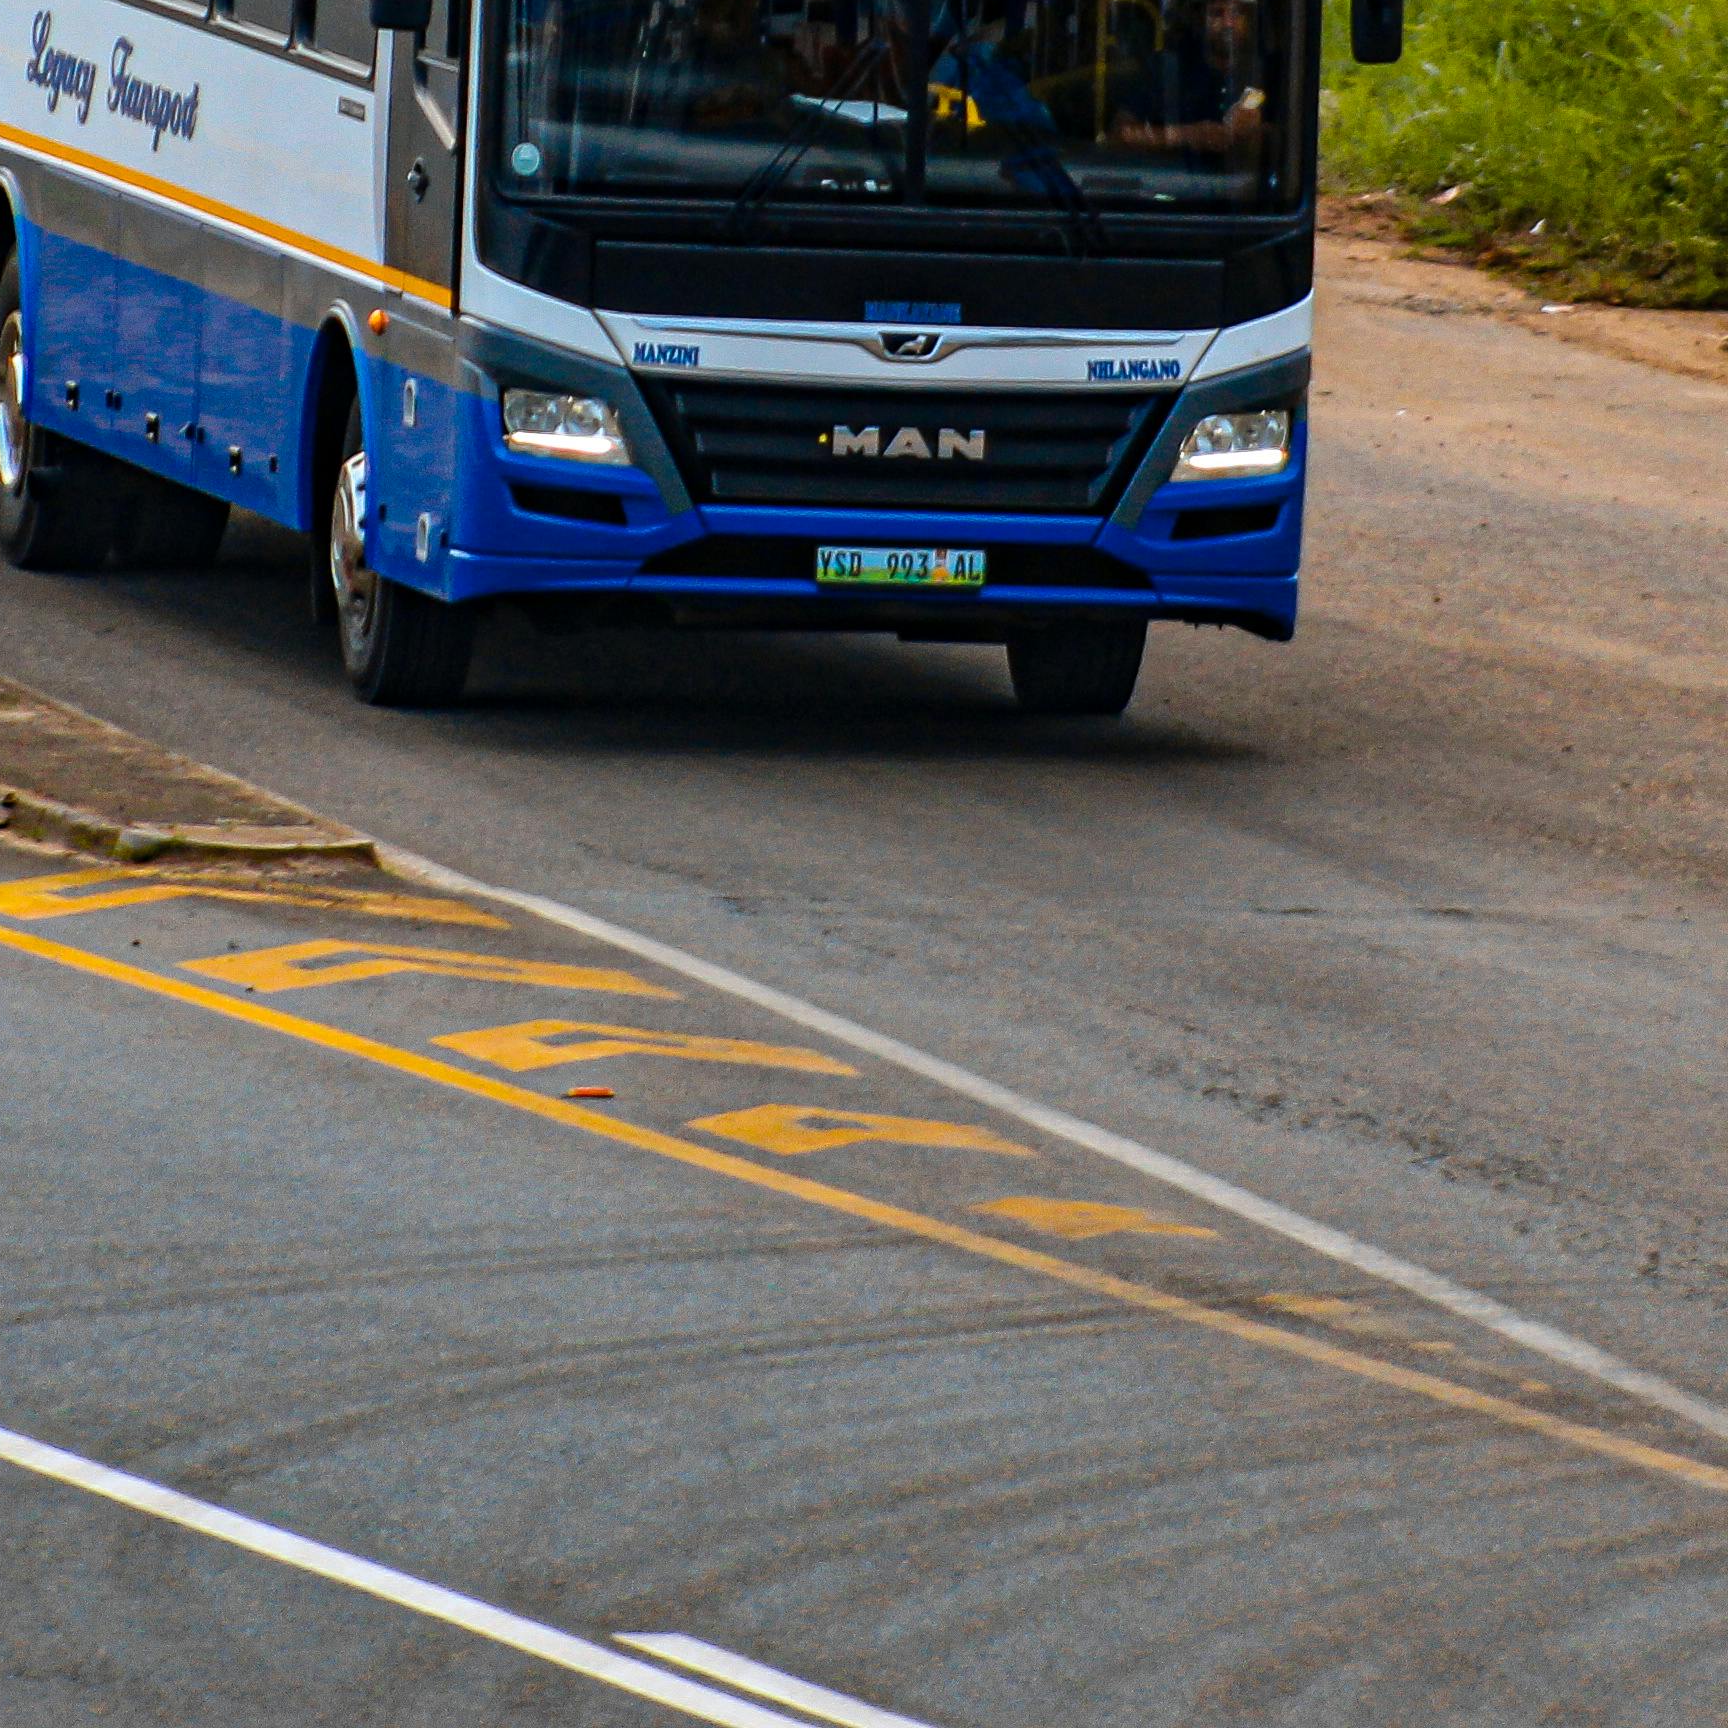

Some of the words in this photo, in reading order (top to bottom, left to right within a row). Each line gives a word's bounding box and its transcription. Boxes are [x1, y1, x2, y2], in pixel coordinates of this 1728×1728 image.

[27, 10, 97, 124] Legacy
[106, 36, 200, 151] Transport
[633, 341, 700, 366] MANZINI
[1087, 358, 1181, 381] NHLANGANO
[833, 425, 985, 460] MAN
[819, 550, 863, 577] YSD
[887, 552, 929, 579] 993
[953, 553, 981, 580] AL
